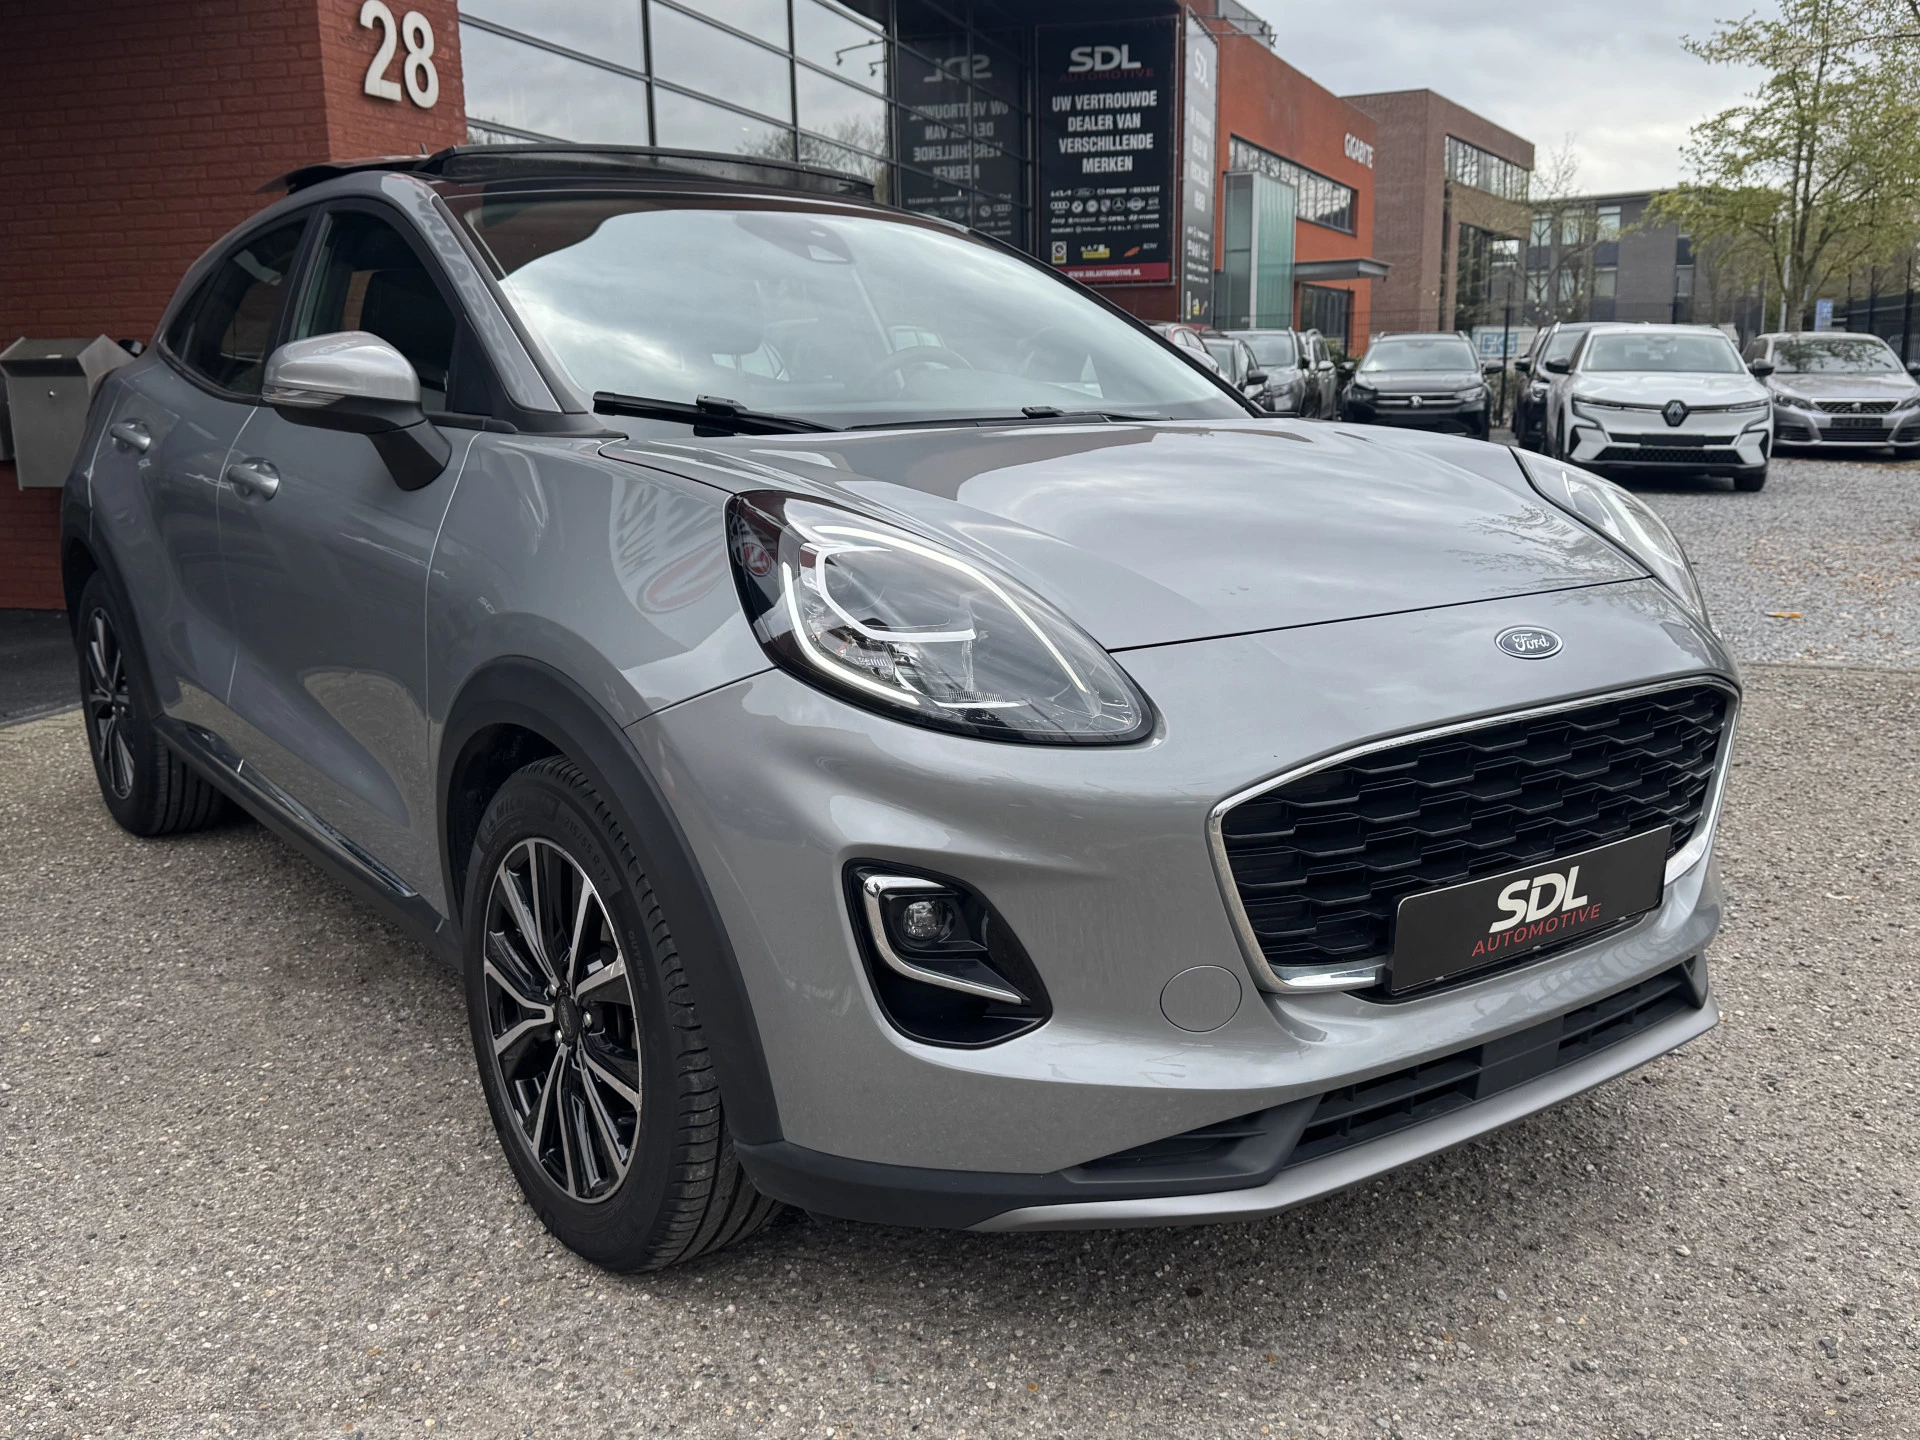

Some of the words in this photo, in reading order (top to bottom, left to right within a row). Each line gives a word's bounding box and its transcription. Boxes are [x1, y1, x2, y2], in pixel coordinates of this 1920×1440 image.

[360, 0, 439, 109] 28
[1068, 44, 1142, 73] SDL
[1058, 68, 1155, 83] AUTOMOTIVE
[1052, 95, 1073, 112] UW
[1074, 90, 1158, 110] VERTROUWDE
[1068, 114, 1113, 133] DEALER
[1117, 112, 1141, 130] VAN
[1058, 132, 1154, 154] VERSCHILLENDE
[1344, 132, 1374, 169] GIGABYTE
[1082, 155, 1133, 173] MERKEN
[1512, 632, 1550, 652] Ford
[563, 817, 593, 855] 215/55
[1489, 866, 1588, 933] SDL
[1472, 903, 1602, 957] AUTOMOTIVE
[628, 930, 650, 990] OUTSIDE
